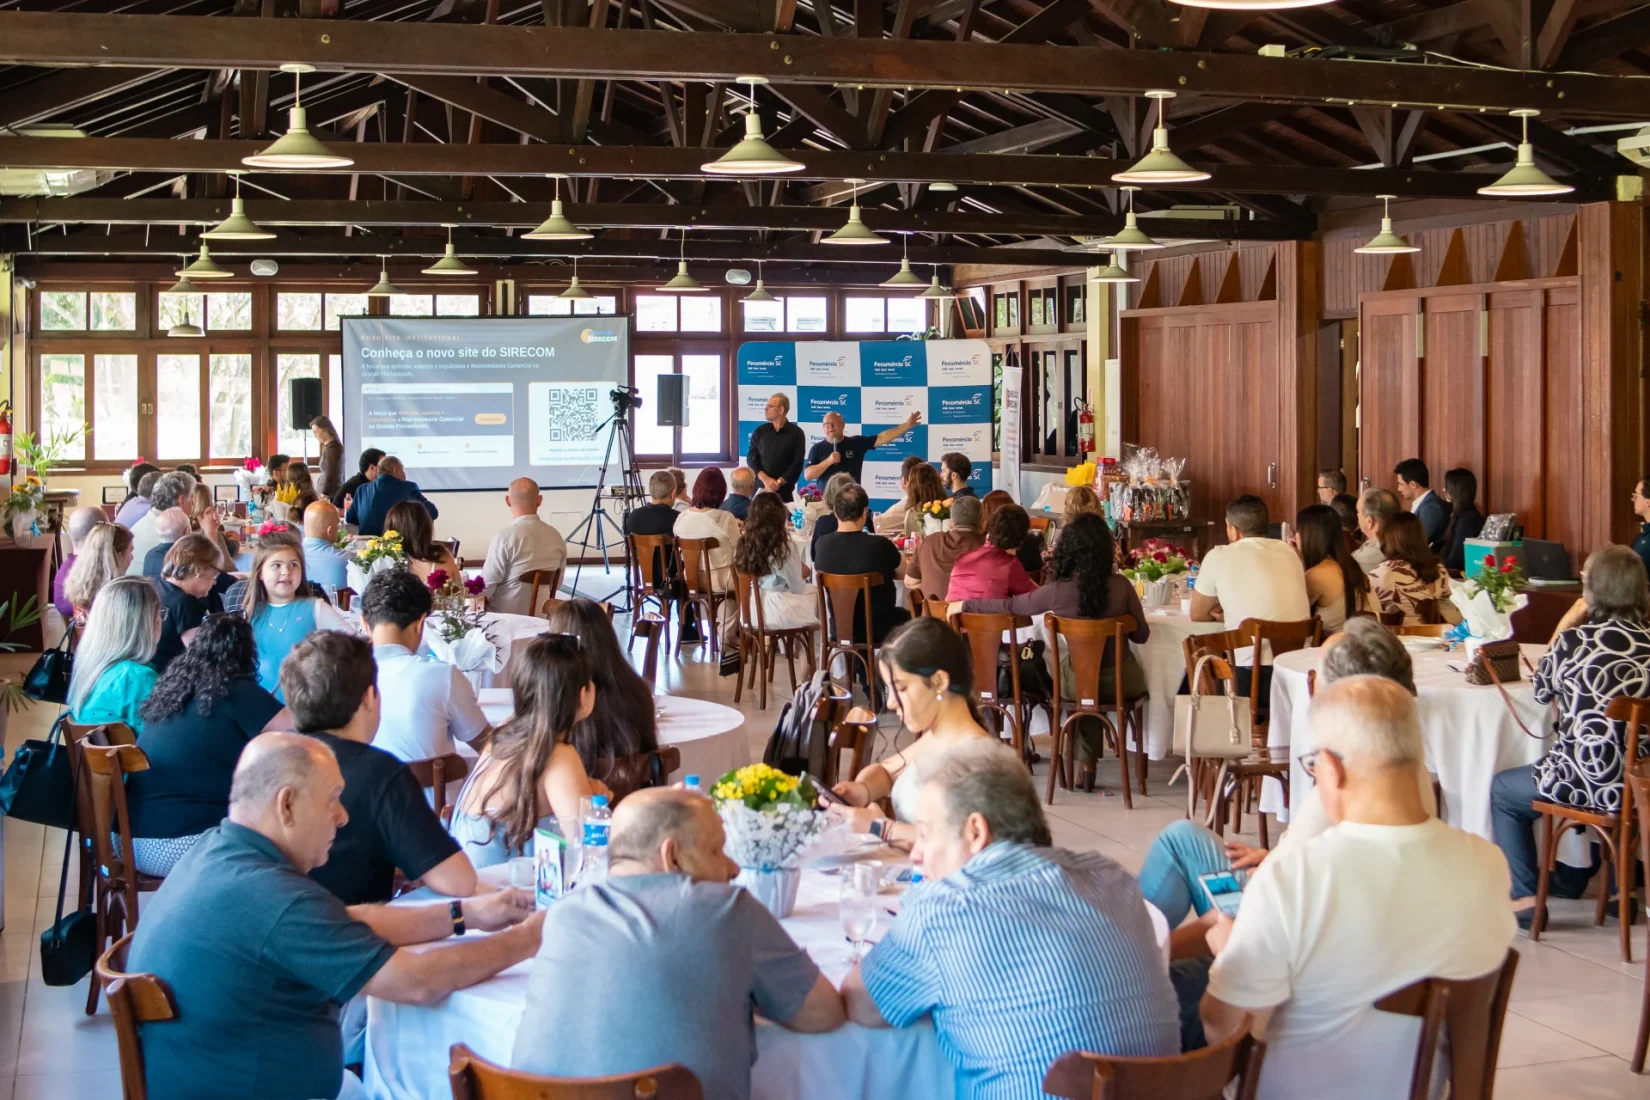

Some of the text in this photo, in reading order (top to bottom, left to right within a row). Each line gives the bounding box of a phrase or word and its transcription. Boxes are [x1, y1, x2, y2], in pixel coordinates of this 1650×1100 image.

[361, 347, 555, 360] Conheça o novo site do SIRECOM
